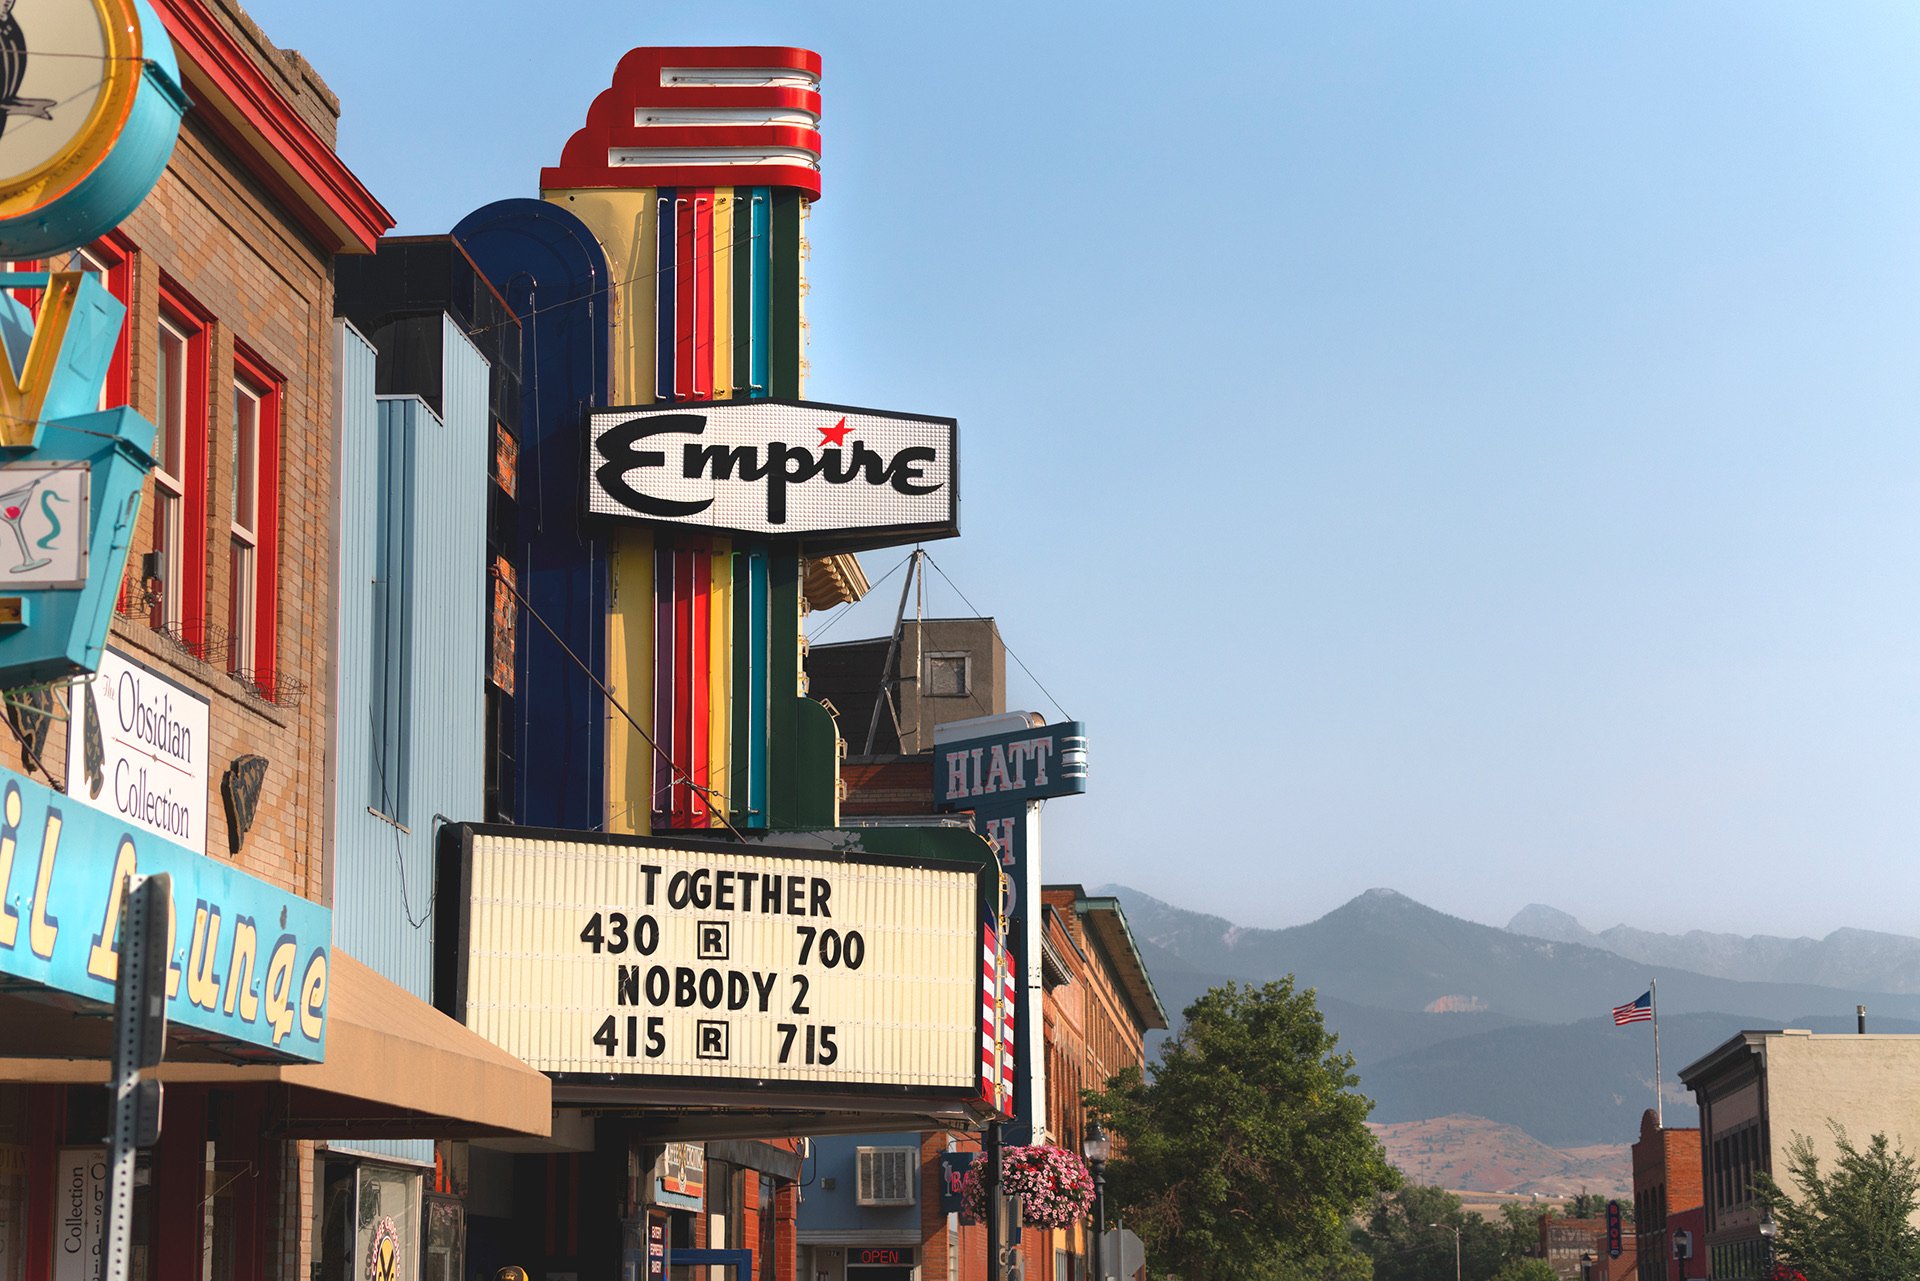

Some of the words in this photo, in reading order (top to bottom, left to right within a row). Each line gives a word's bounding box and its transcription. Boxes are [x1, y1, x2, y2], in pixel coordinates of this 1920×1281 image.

[595, 414, 945, 525] Empire
[103, 674, 115, 701] The
[118, 670, 192, 764] Obsidian
[114, 757, 189, 839] Collection
[945, 736, 1053, 800] HIATT
[640, 864, 832, 918] TOGETHER
[580, 912, 660, 956] 430
[700, 925, 726, 956] R
[796, 925, 865, 970] 700
[617, 964, 778, 1012] NOBODY
[792, 974, 810, 1015] 2
[592, 1014, 666, 1058] 415
[700, 1024, 726, 1056] R
[776, 1023, 838, 1066] 715
[64, 1166, 85, 1254] Collection
[90, 1162, 107, 1281] Obsidi
[861, 1250, 899, 1264] OPEN
